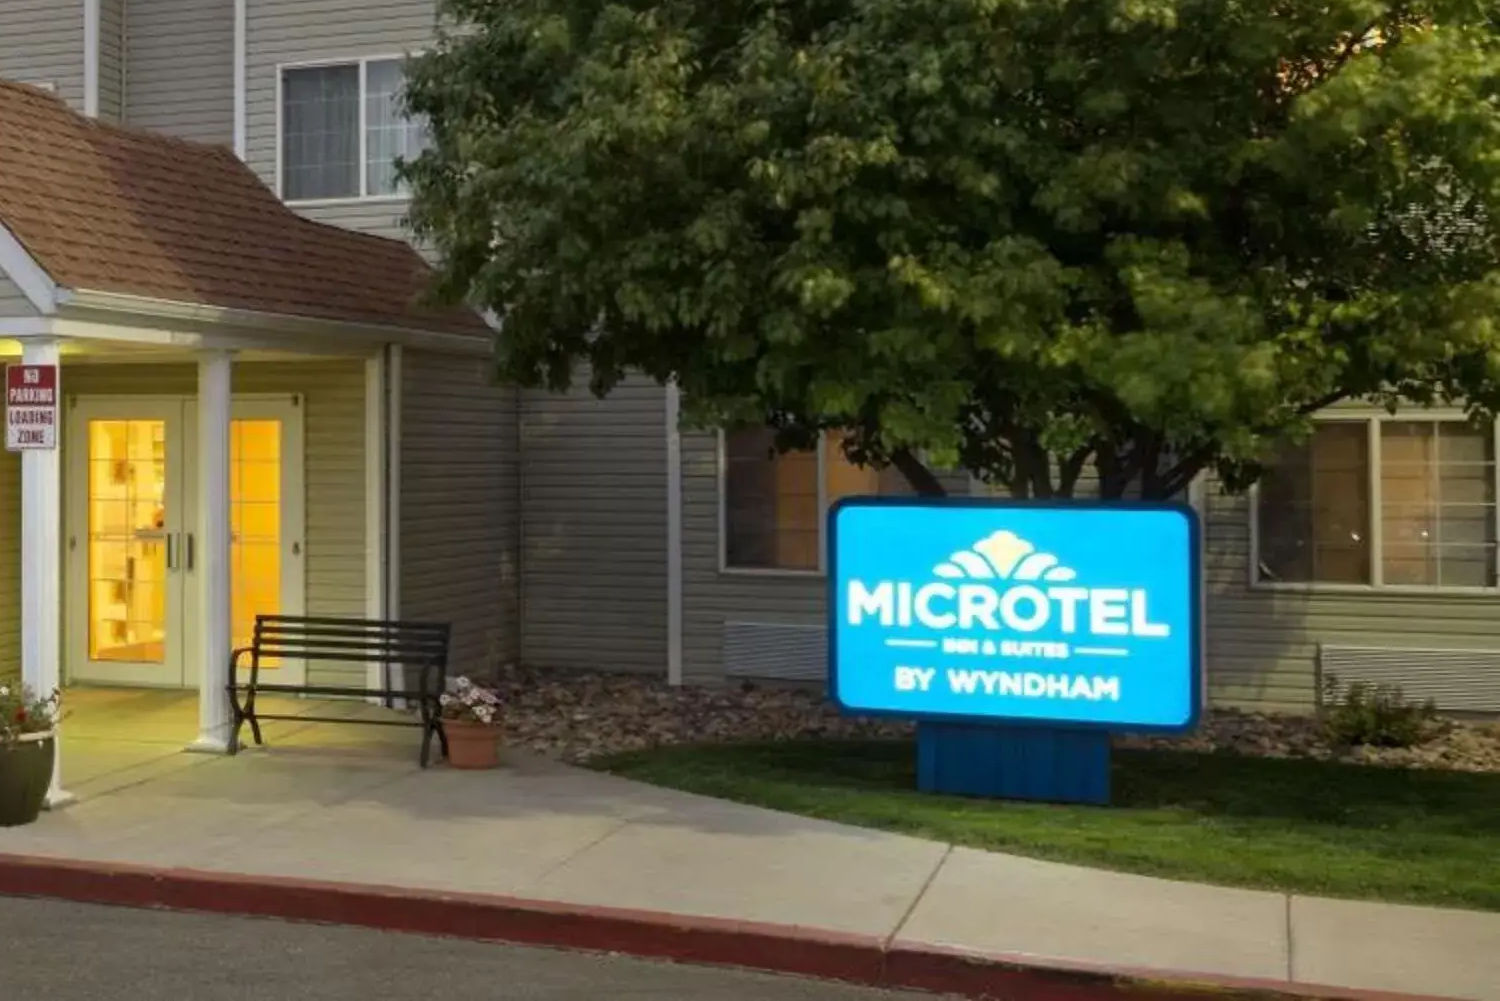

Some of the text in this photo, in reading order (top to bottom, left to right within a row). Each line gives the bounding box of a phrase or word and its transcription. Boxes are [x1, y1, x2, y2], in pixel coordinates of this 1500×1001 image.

[23, 368, 40, 384] NO
[9, 387, 54, 403] PARKING
[9, 410, 54, 426] LOADING
[18, 429, 45, 444] ZONE
[846, 578, 1171, 638] MICROTEL
[982, 639, 997, 655] &
[1000, 639, 1070, 659] SUITES
[894, 665, 1121, 702] BY WYNDHAM
